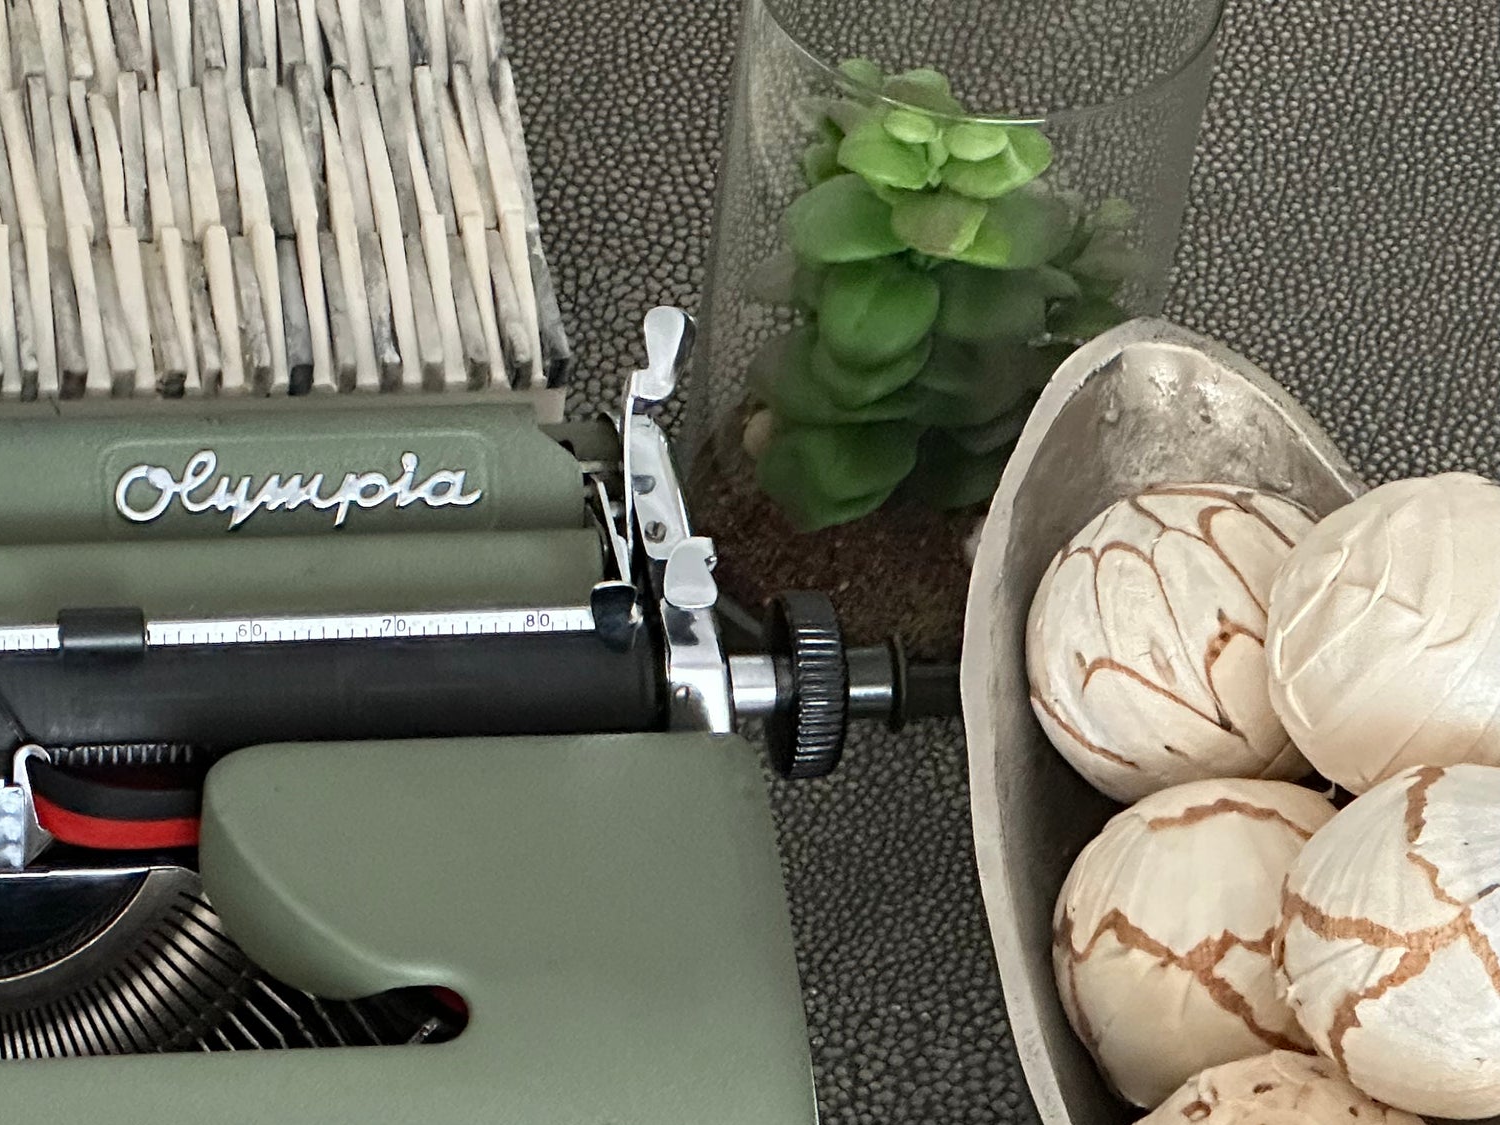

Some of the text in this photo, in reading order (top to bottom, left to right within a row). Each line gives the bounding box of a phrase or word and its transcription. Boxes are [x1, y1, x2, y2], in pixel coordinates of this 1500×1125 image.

[114, 448, 483, 531] Olympia
[238, 623, 262, 638] 60
[382, 619, 406, 632] 70
[526, 613, 550, 628] 80
